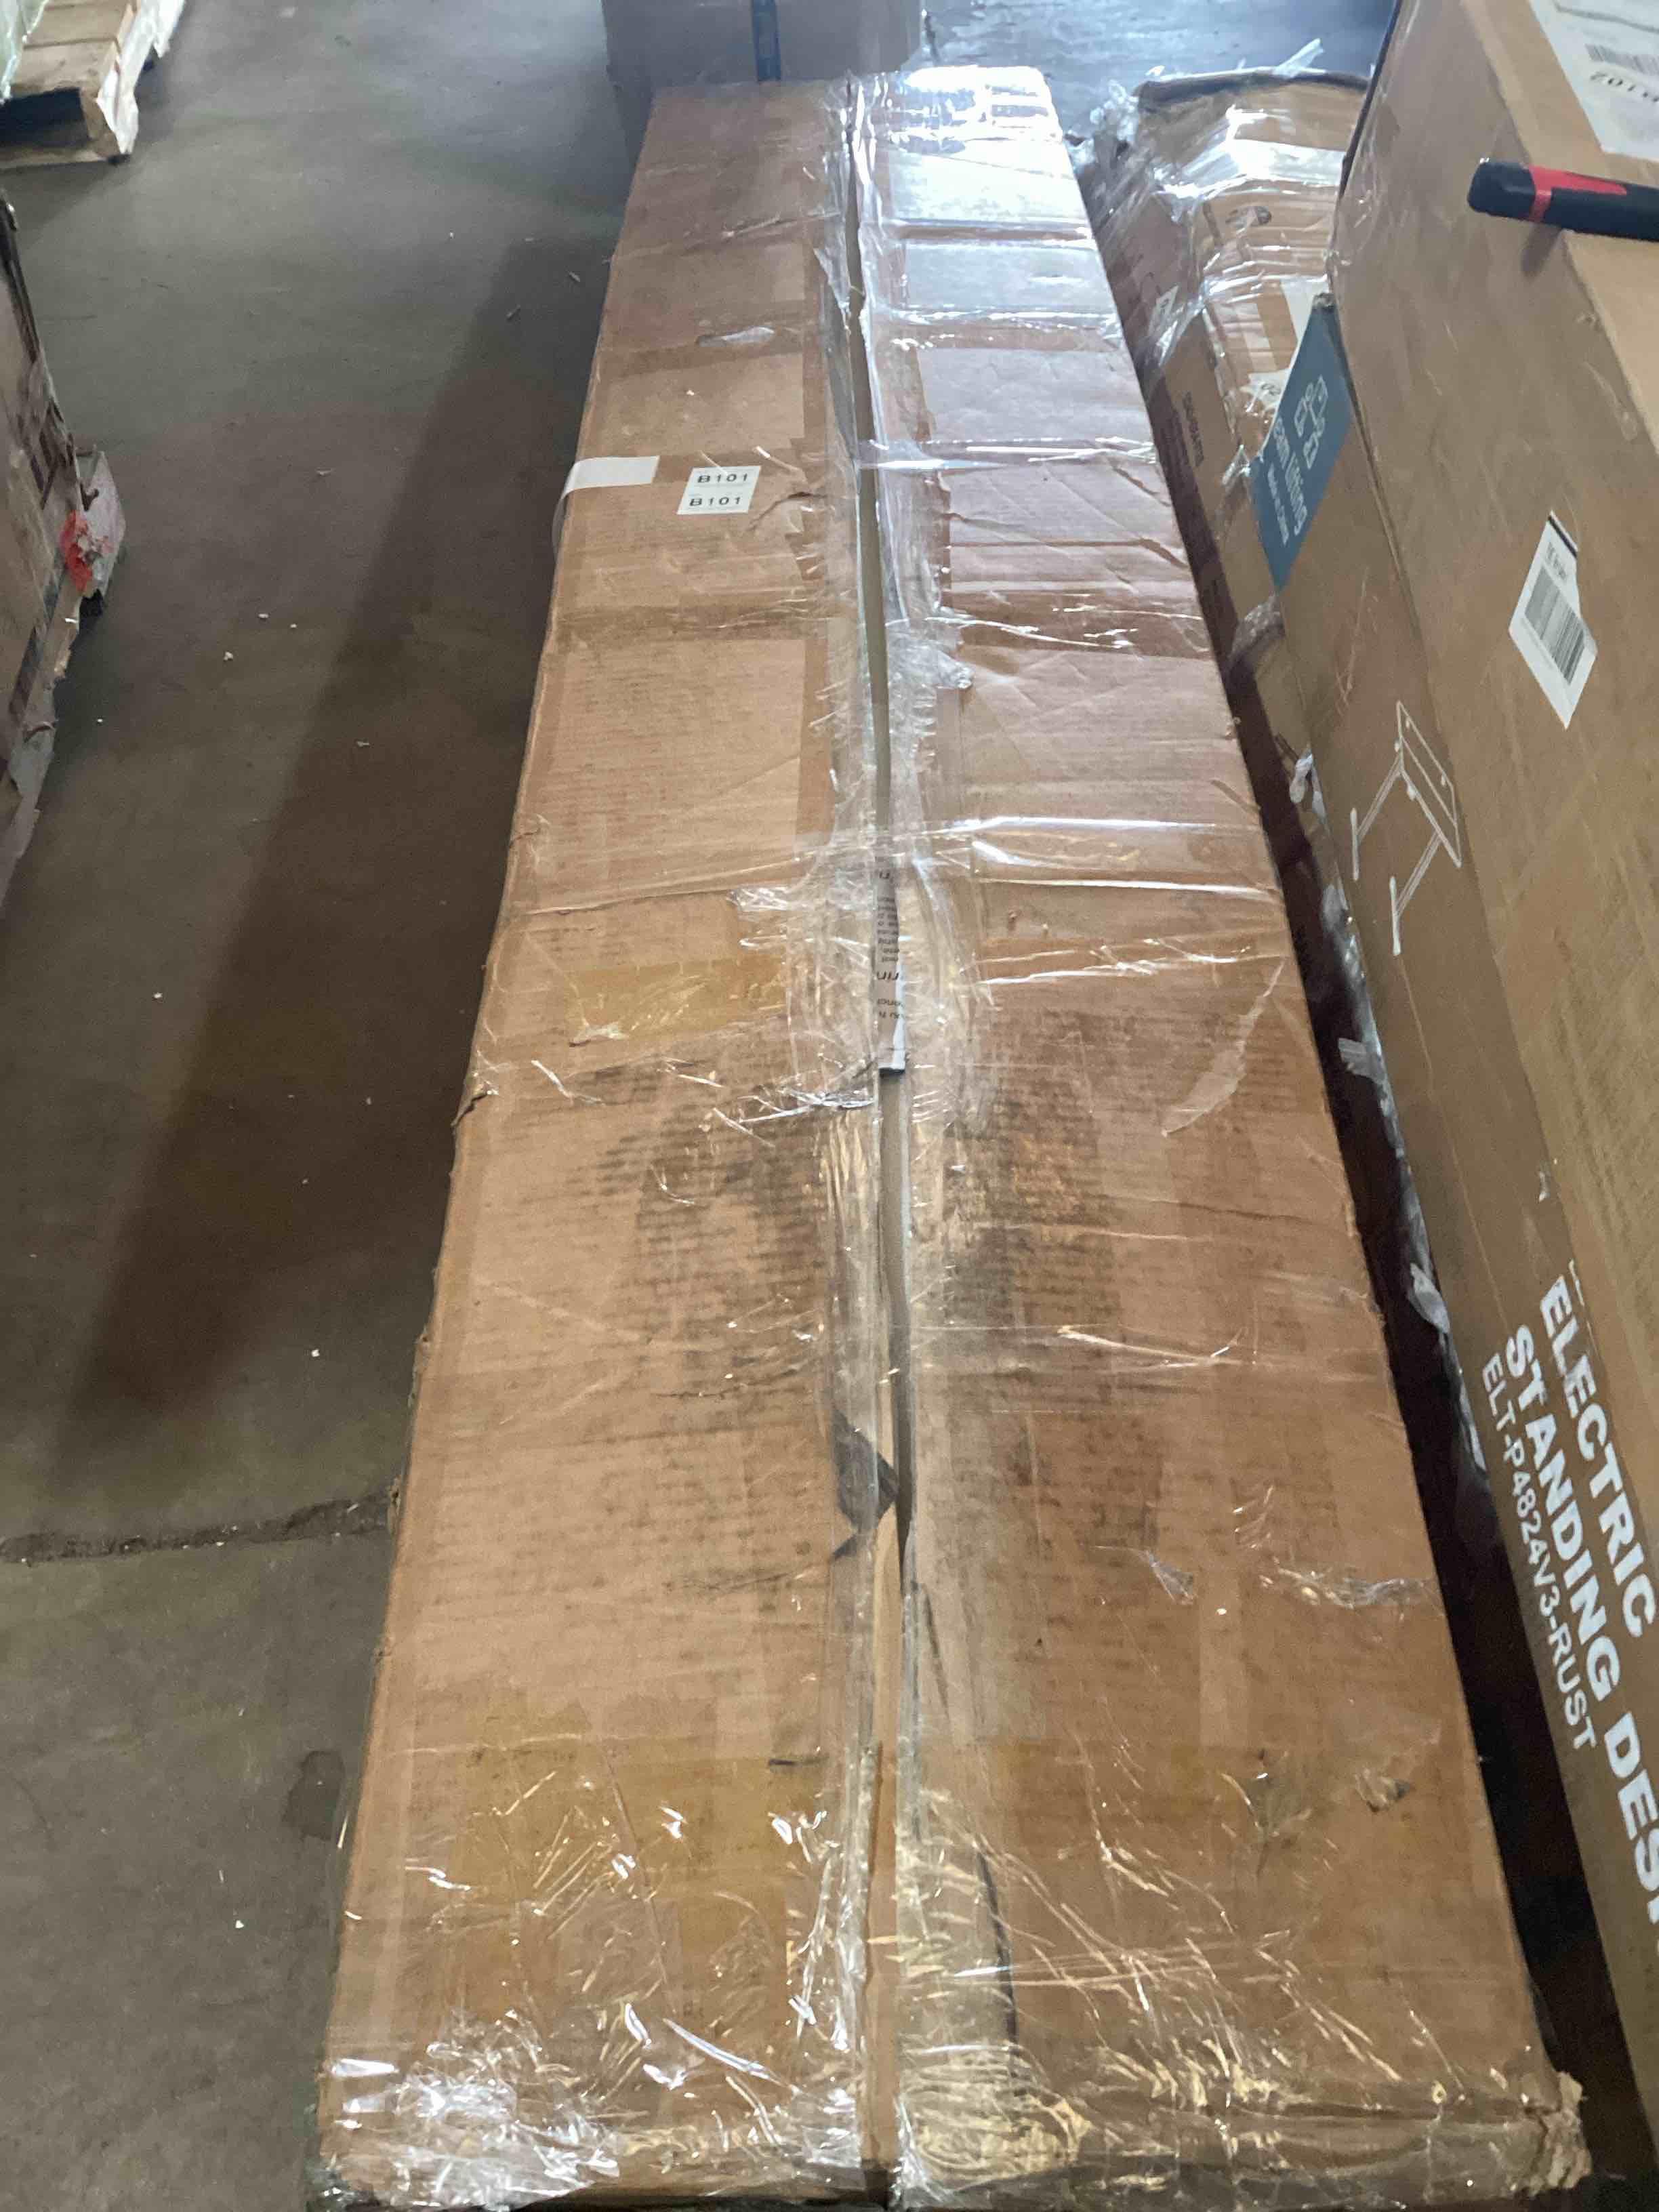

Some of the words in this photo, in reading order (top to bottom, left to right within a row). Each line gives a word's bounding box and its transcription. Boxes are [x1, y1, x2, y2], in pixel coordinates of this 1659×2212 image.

[689, 497, 741, 506] B101
[697, 474, 748, 483] B101
[1482, 1353, 1597, 1748] ELT-P4824V3-RUST
[1540, 1277, 1656, 1638] ELECTRIC
[1505, 1326, 1620, 1702] STANDING
[1604, 1712, 1659, 1956] DES
